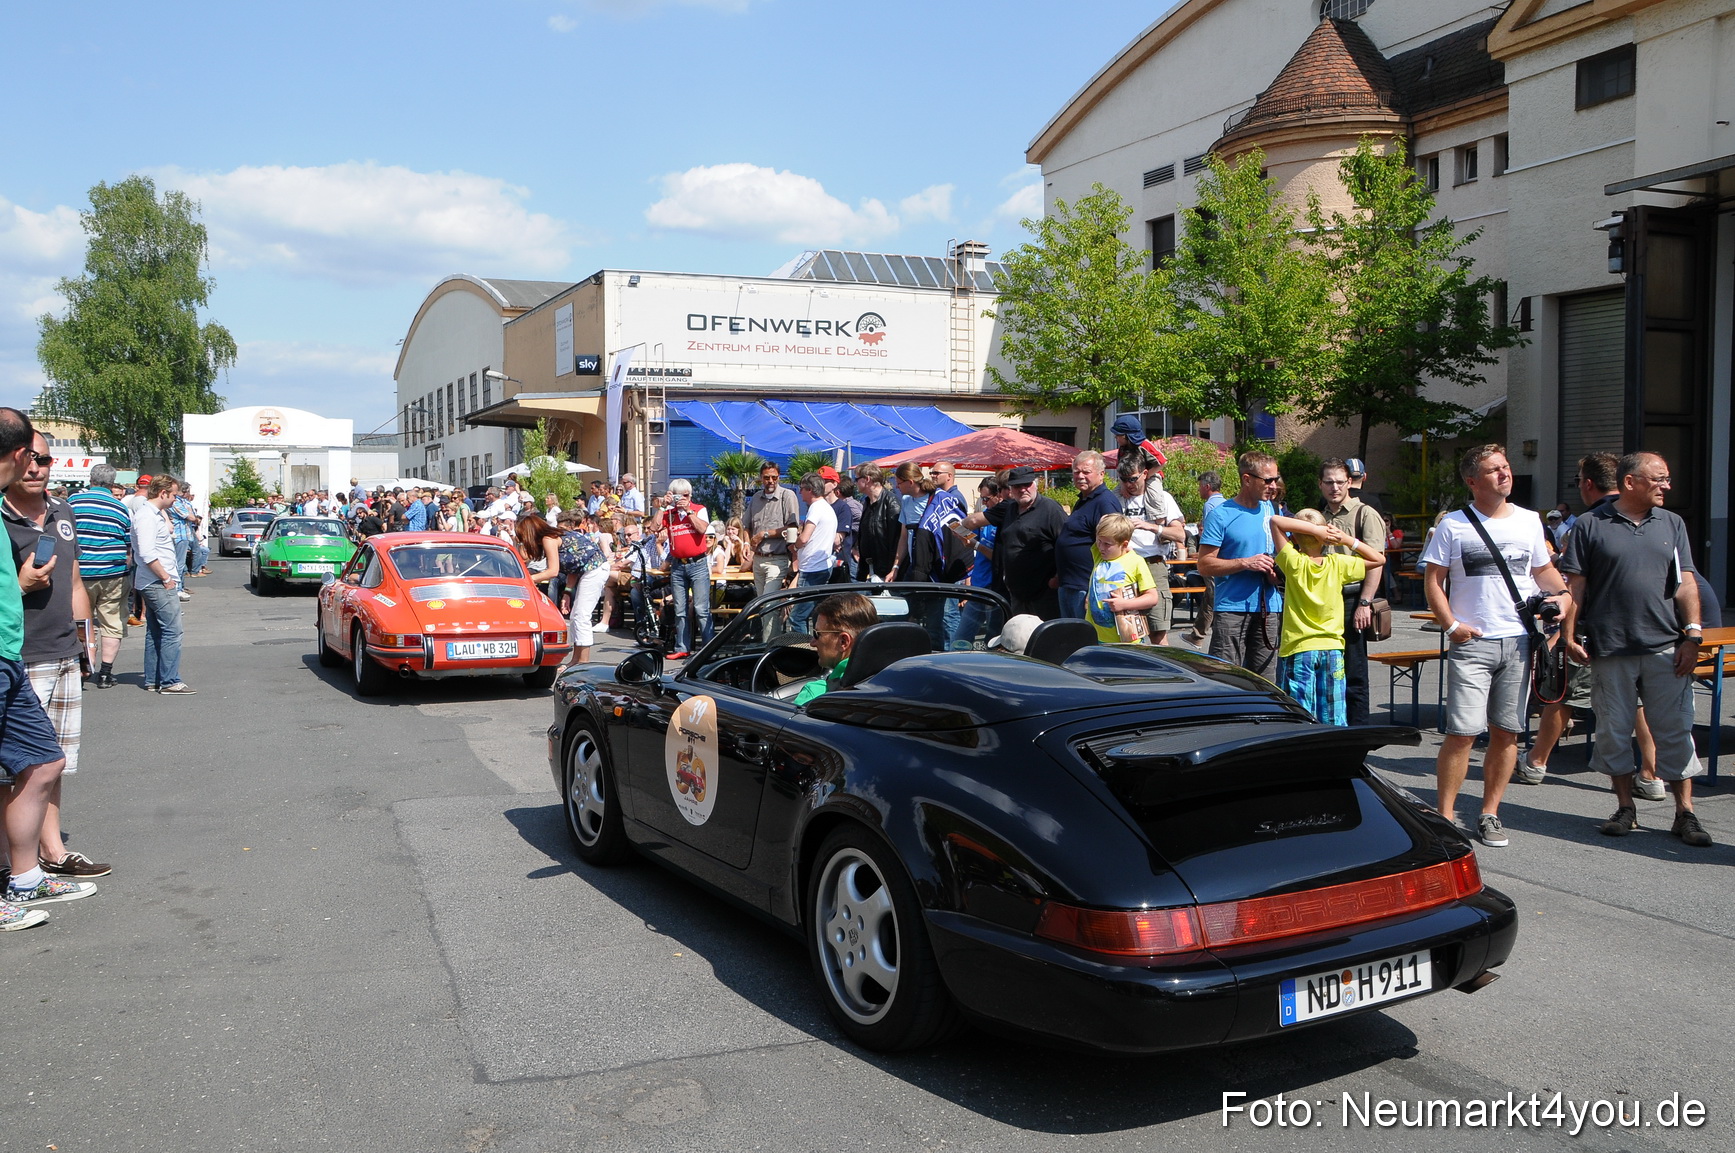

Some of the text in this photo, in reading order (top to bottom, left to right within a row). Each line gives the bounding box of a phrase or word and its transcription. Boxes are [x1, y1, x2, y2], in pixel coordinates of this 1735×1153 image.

[687, 313, 853, 338] OFENWERK
[1511, 296, 1535, 332] 4
[579, 359, 598, 371] sky
[454, 641, 518, 656] LAU WB 32H
[689, 700, 708, 724] 39
[679, 726, 706, 743] PORSCHE
[1285, 1005, 1292, 1016] D
[1307, 972, 1341, 1014] ND
